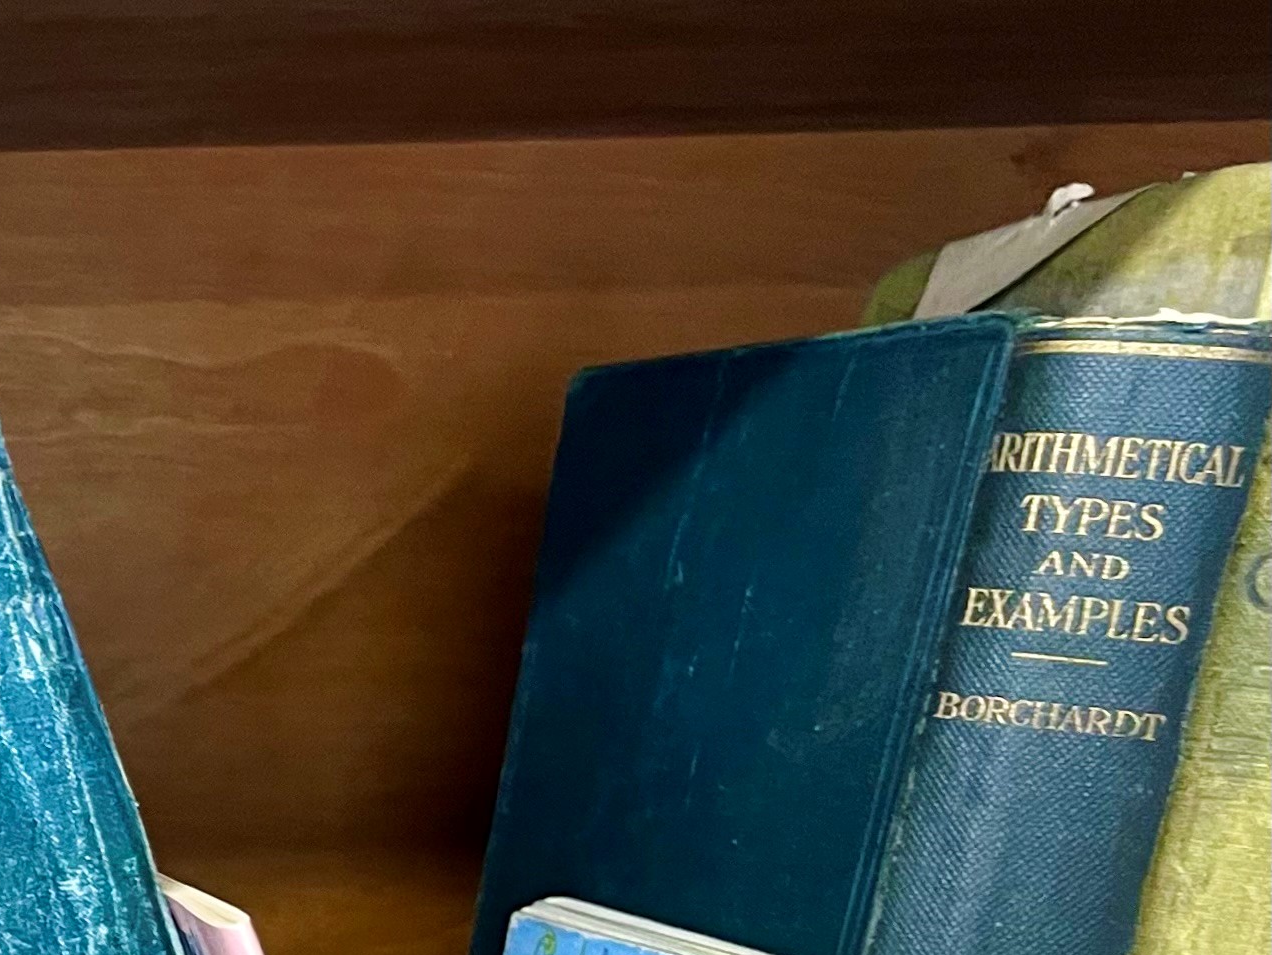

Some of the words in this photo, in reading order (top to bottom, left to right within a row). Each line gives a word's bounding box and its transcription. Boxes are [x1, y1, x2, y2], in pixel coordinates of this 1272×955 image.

[1020, 494, 1166, 542] TYPES
[1032, 550, 1131, 580] AND
[960, 587, 1191, 645] EXAMPLES
[934, 691, 1166, 742] BORCHARDT
